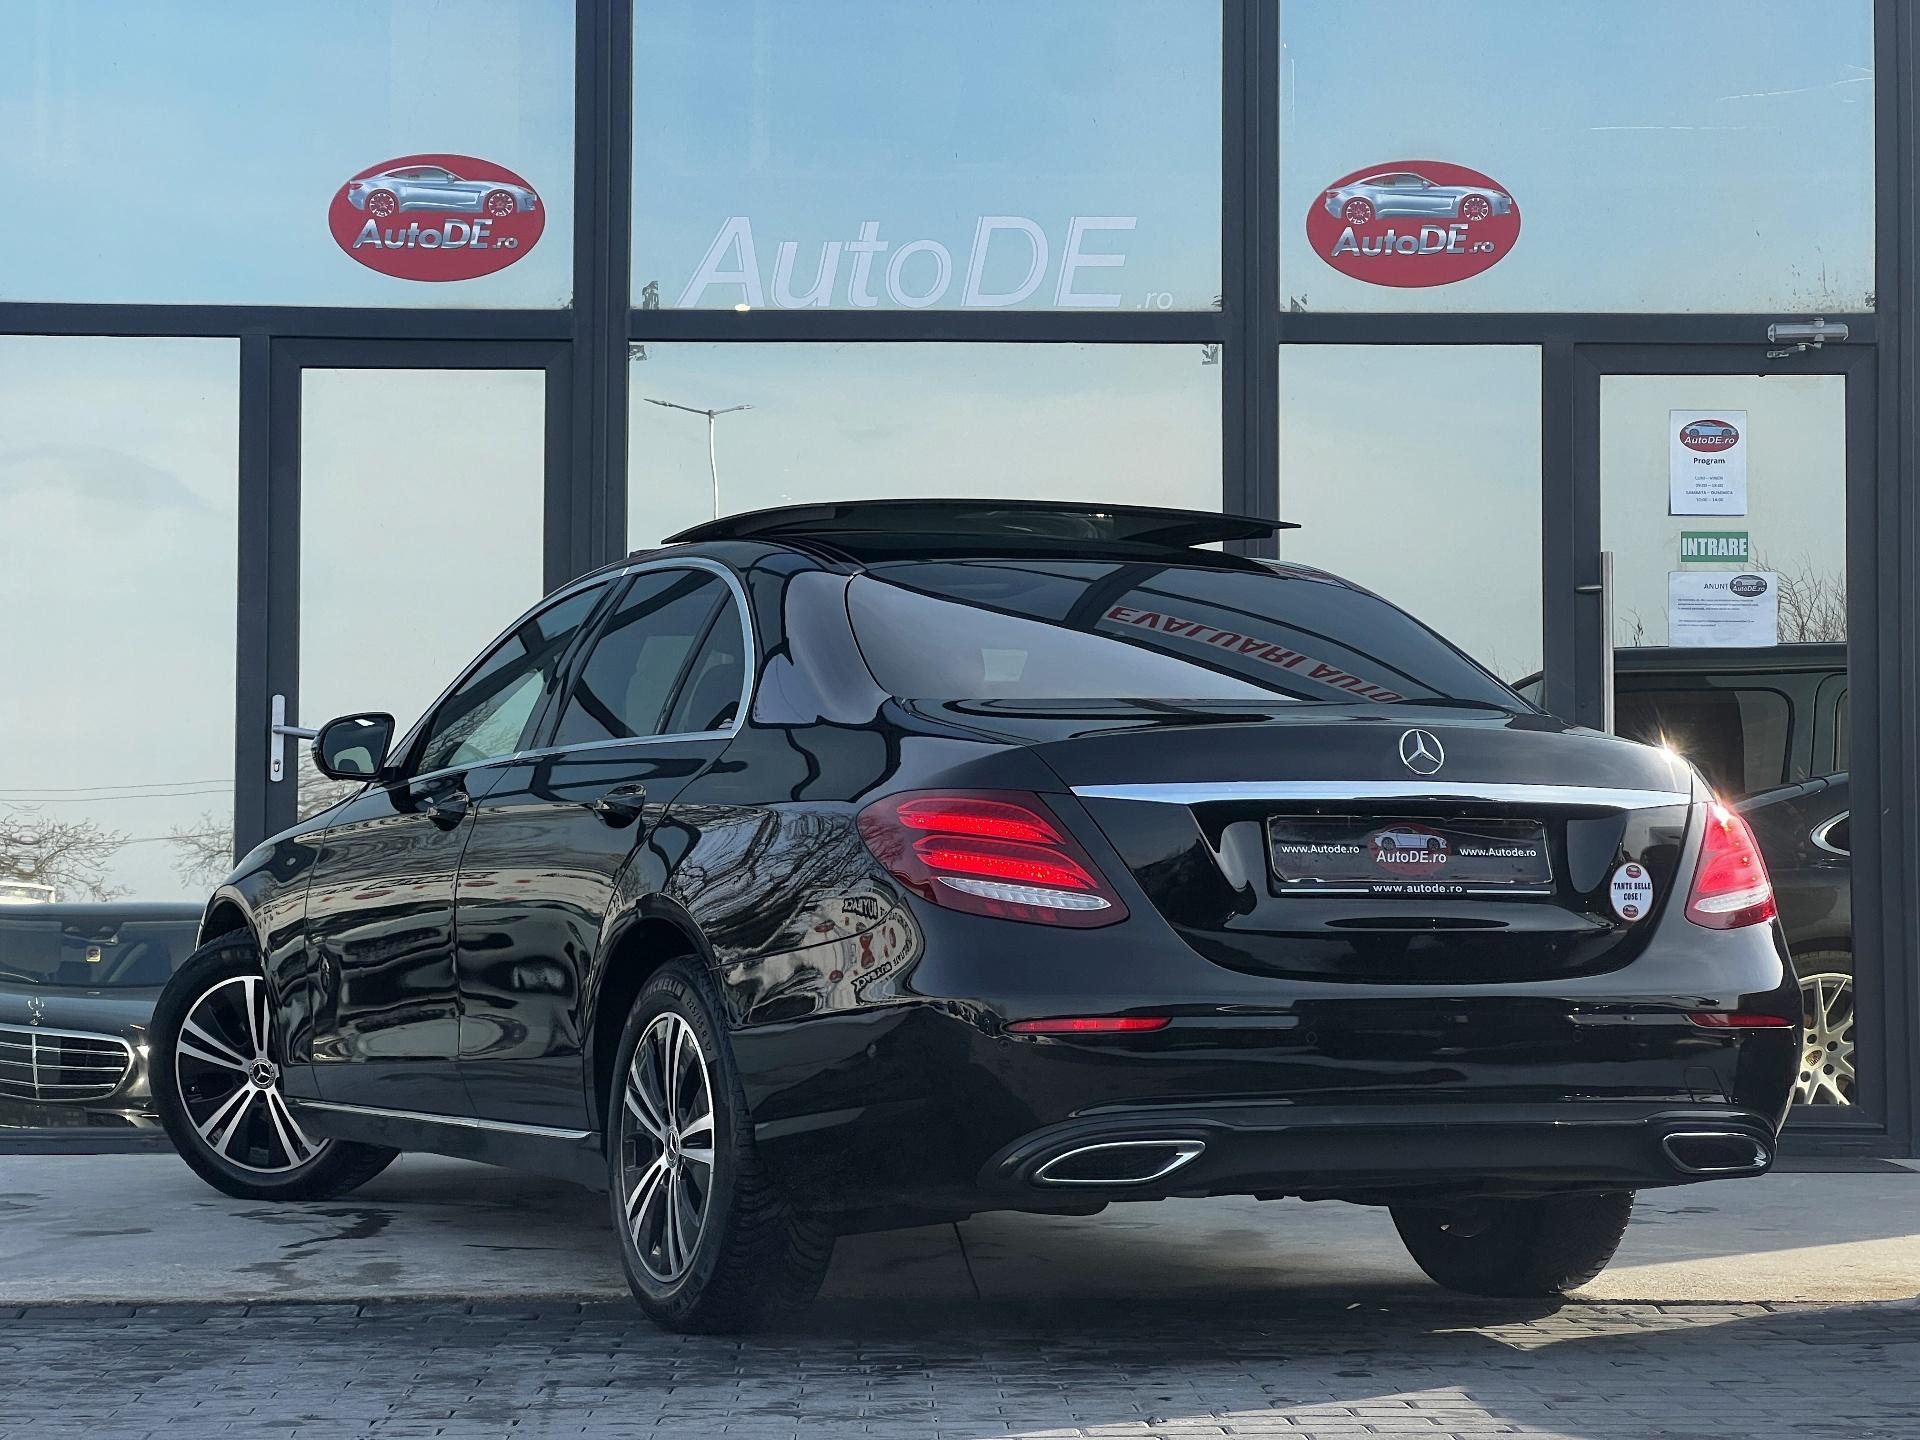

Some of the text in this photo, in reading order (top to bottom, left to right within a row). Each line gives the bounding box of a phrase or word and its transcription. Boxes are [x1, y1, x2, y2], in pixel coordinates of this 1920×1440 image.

[1684, 436, 1735, 445] AutoDE.ro
[1693, 457, 1725, 465] Program
[1682, 538, 1747, 556] INTRARE
[1281, 844, 1360, 854] www.Autode.ro
[1459, 847, 1537, 858] www.Autode.ro
[1376, 850, 1447, 864] AutoDE.ro
[1372, 884, 1463, 893] www.autode.ro
[1613, 882, 1651, 890] TANTE BELLE
[1623, 893, 1638, 901] COSE
